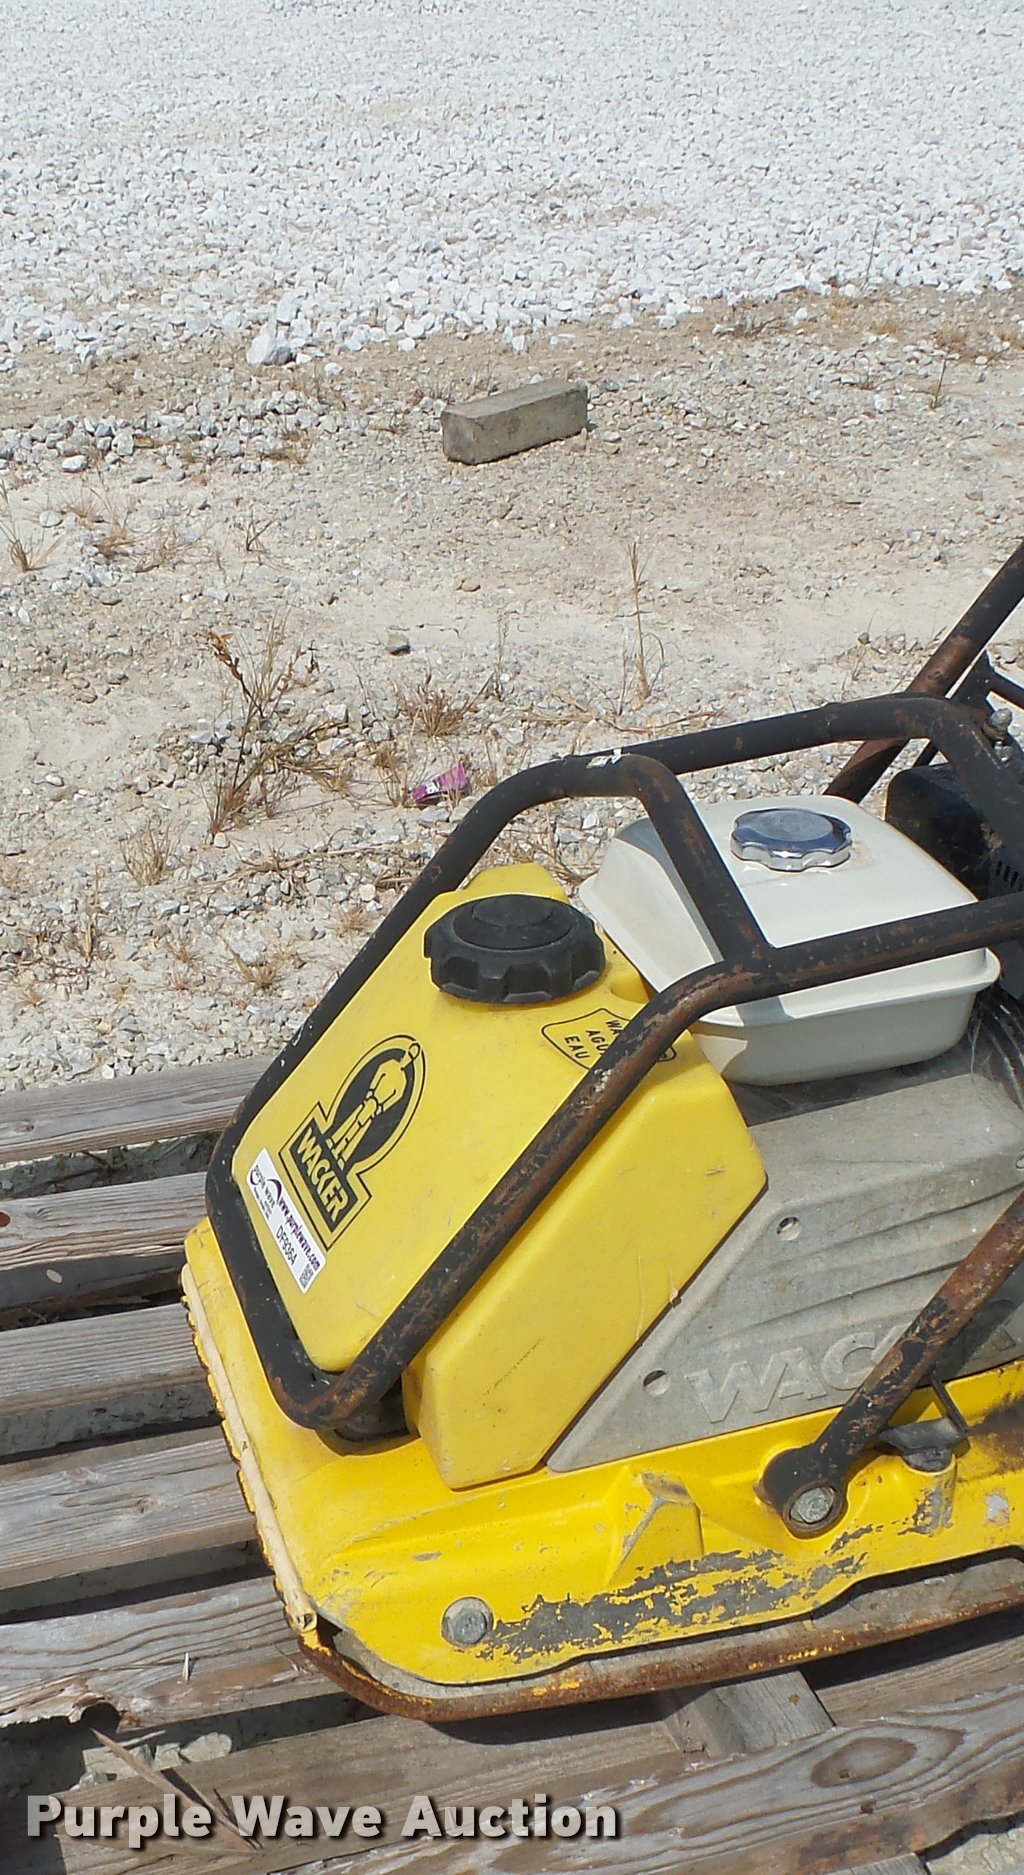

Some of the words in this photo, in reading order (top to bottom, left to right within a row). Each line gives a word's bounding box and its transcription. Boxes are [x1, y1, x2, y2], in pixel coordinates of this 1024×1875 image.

[564, 1035, 590, 1060] EAU
[585, 1030, 609, 1056] AGU
[296, 1126, 350, 1222] WACKER
